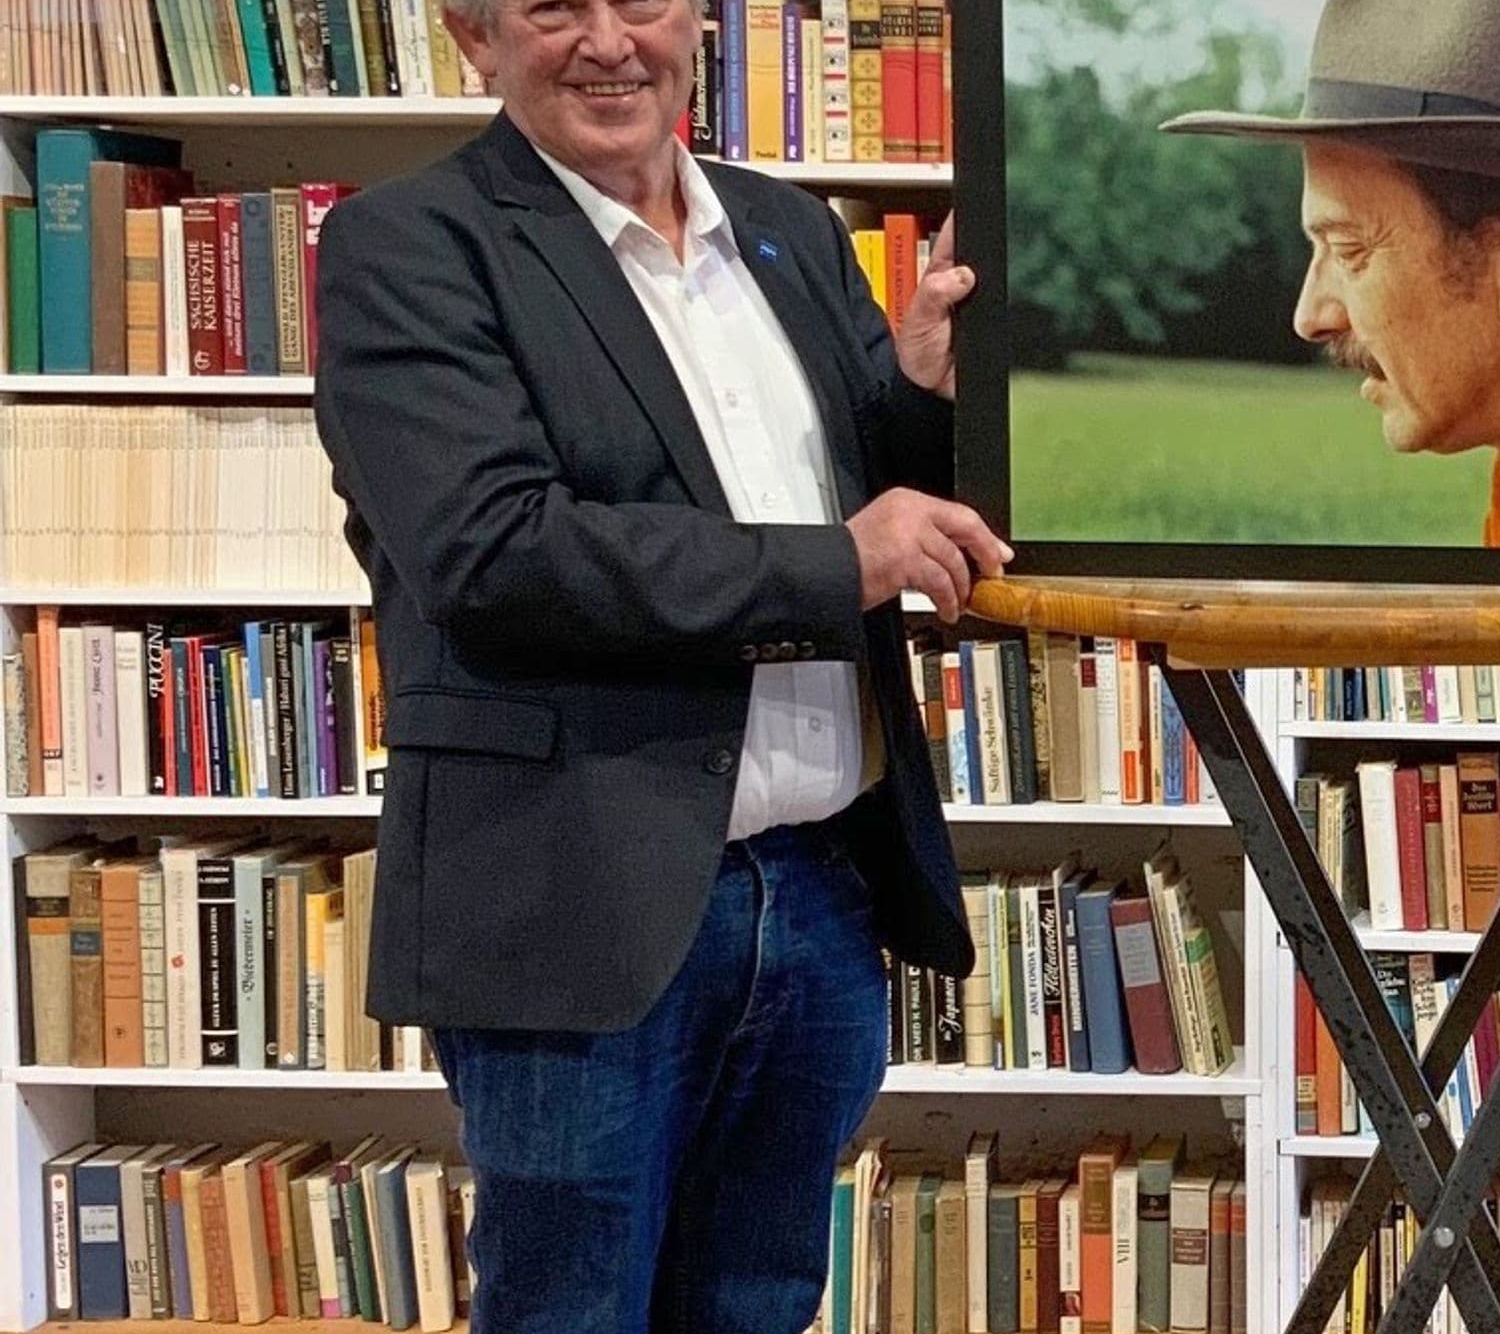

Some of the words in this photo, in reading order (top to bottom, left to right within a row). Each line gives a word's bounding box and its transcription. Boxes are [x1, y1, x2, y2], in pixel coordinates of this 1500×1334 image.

[231, 236, 240, 262] allein
[201, 240, 217, 332] KAISERZEIT
[231, 264, 241, 299] Kleinen
[232, 300, 242, 320] drei
[288, 300, 298, 320] DES
[233, 322, 244, 357] meinen
[289, 325, 299, 358] GANG
[274, 628, 287, 657] Afrika
[146, 622, 165, 699] PUCCINI
[982, 687, 997, 749] Schwänke
[282, 773, 294, 796] Hans
[986, 750, 1001, 793] Saftige
[240, 919, 255, 995] Biedermeier
[1040, 907, 1061, 997] Flitterwochen
[1027, 952, 1039, 988] FONDA
[1029, 990, 1040, 1016] JANE
[1066, 945, 1082, 1032] MINDERHEITEN
[53, 1200, 65, 1223] Wind
[54, 1223, 66, 1240] den
[55, 1242, 69, 1270] Gegen
[1116, 1238, 1130, 1265] VIII
